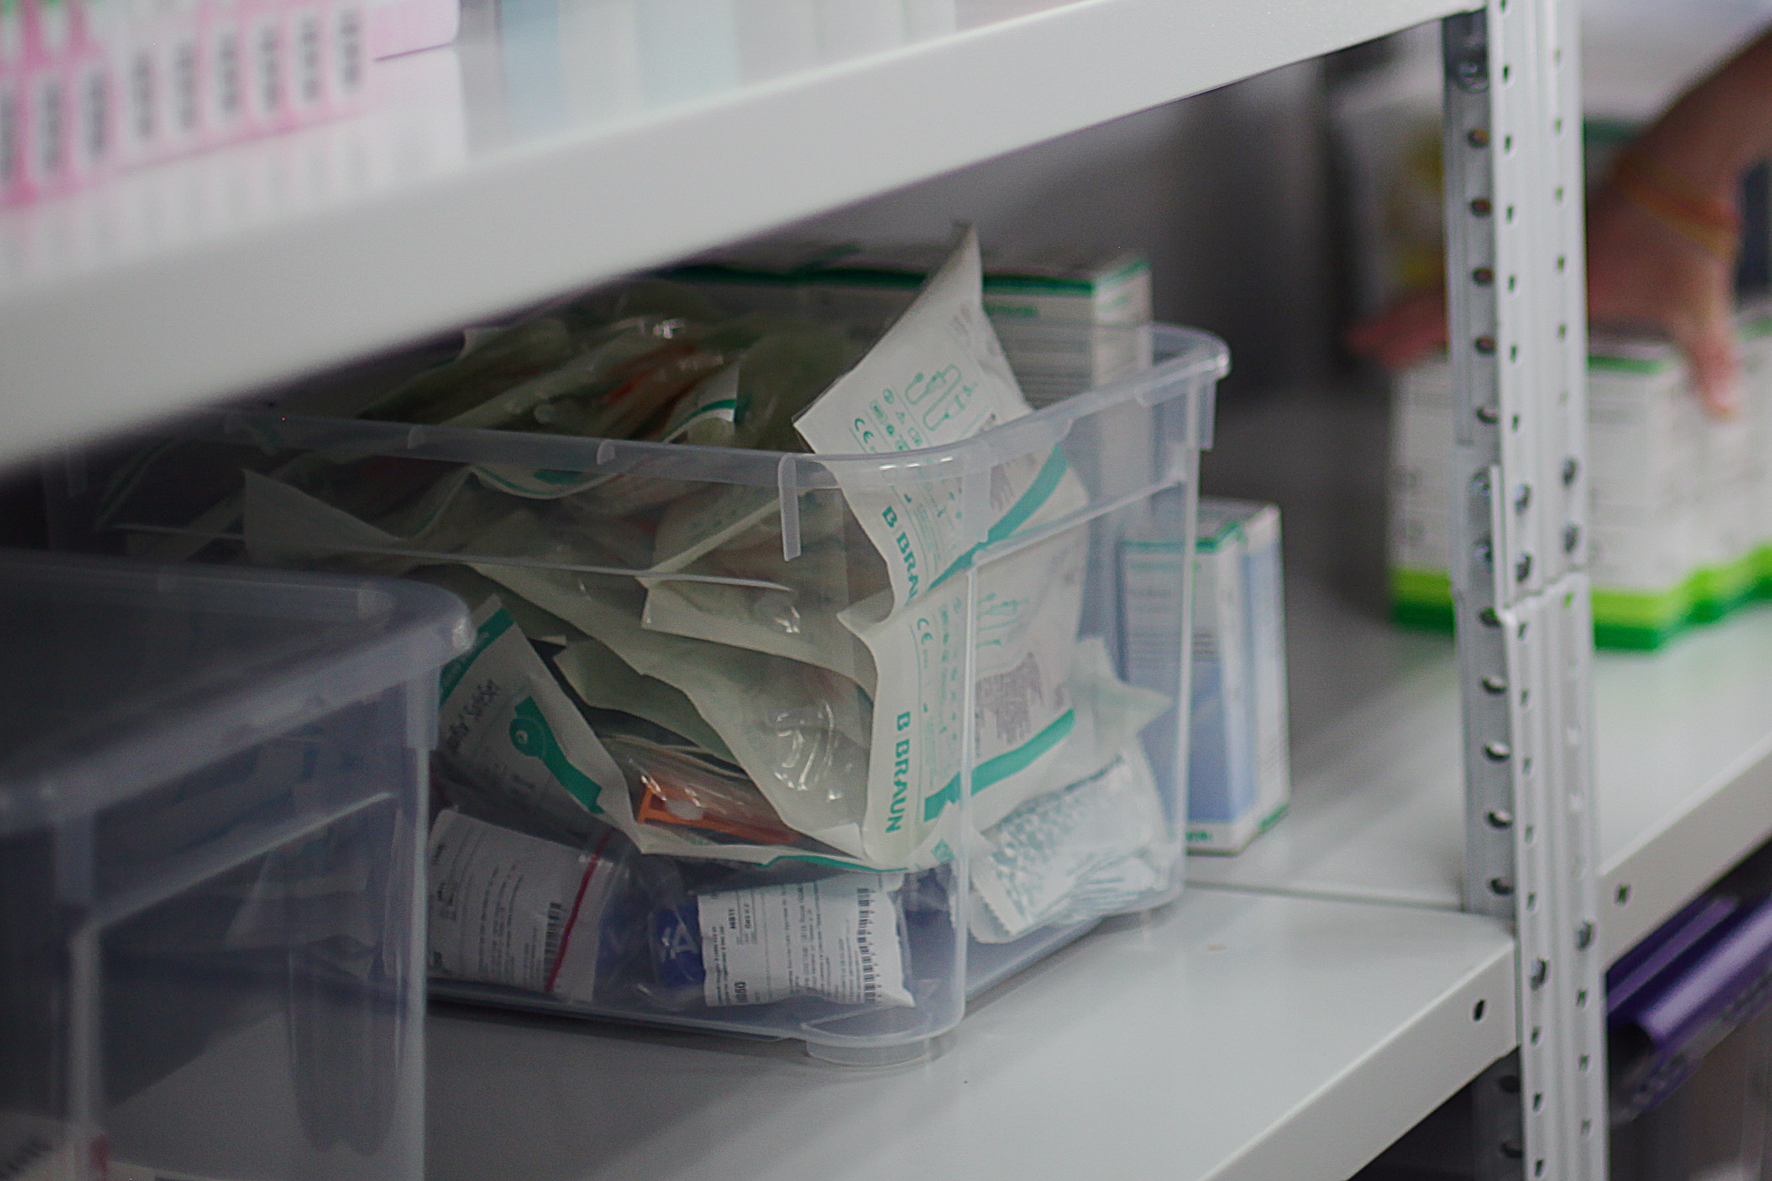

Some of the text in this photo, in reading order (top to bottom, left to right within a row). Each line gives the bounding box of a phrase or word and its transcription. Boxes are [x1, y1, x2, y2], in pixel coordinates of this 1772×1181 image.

[882, 506, 897, 528] B
[885, 711, 911, 834] B BRAUN
